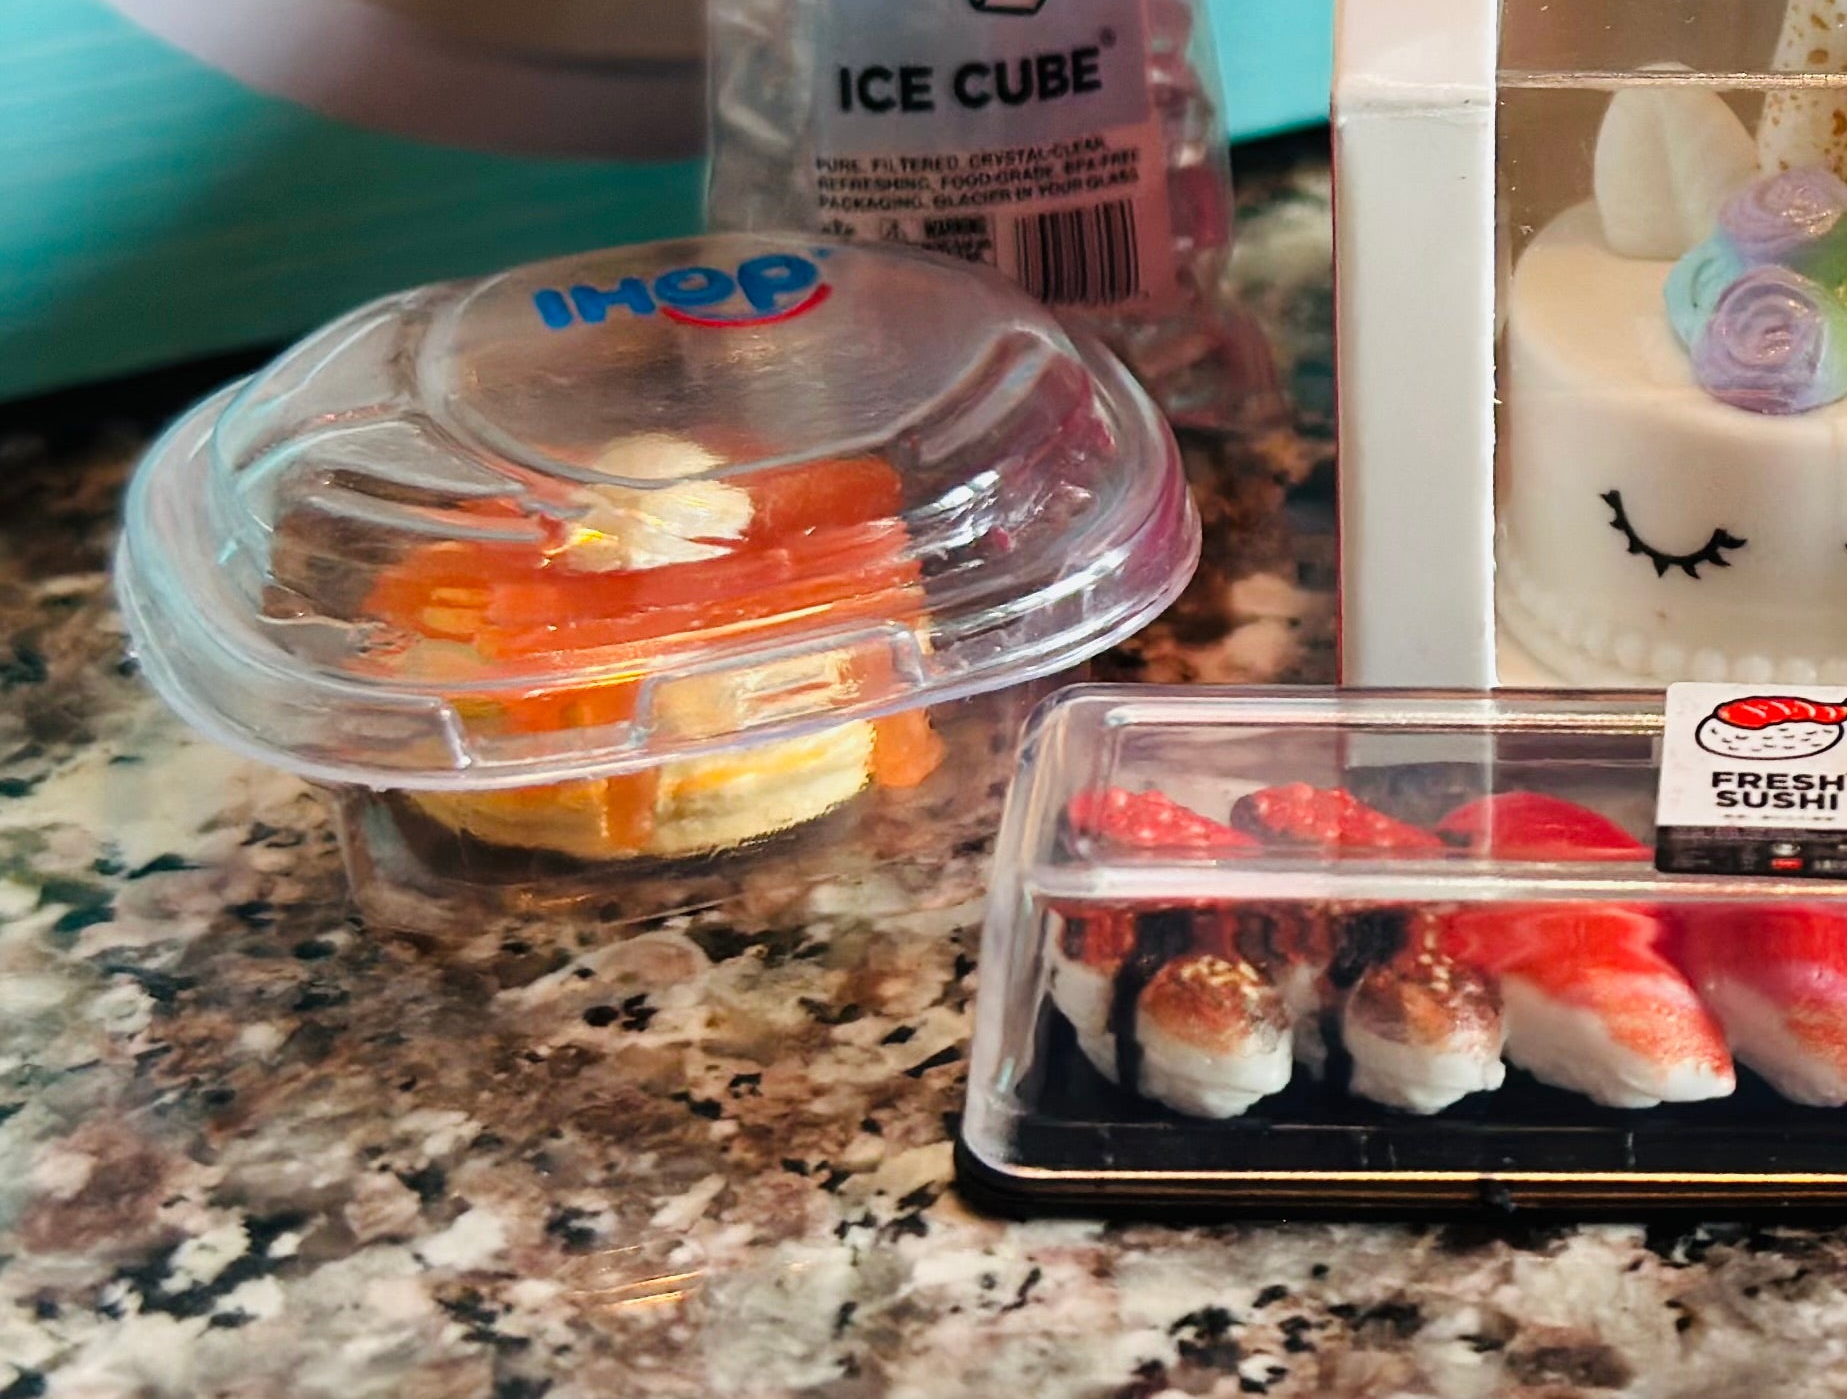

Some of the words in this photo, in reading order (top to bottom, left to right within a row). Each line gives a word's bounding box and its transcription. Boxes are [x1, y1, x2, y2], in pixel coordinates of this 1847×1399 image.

[839, 64, 935, 114] ICE
[952, 46, 1103, 112] CUBE
[1038, 178, 1083, 198] YOUR
[1711, 771, 1846, 791] FRESH
[1715, 790, 1839, 810] SUSHI
